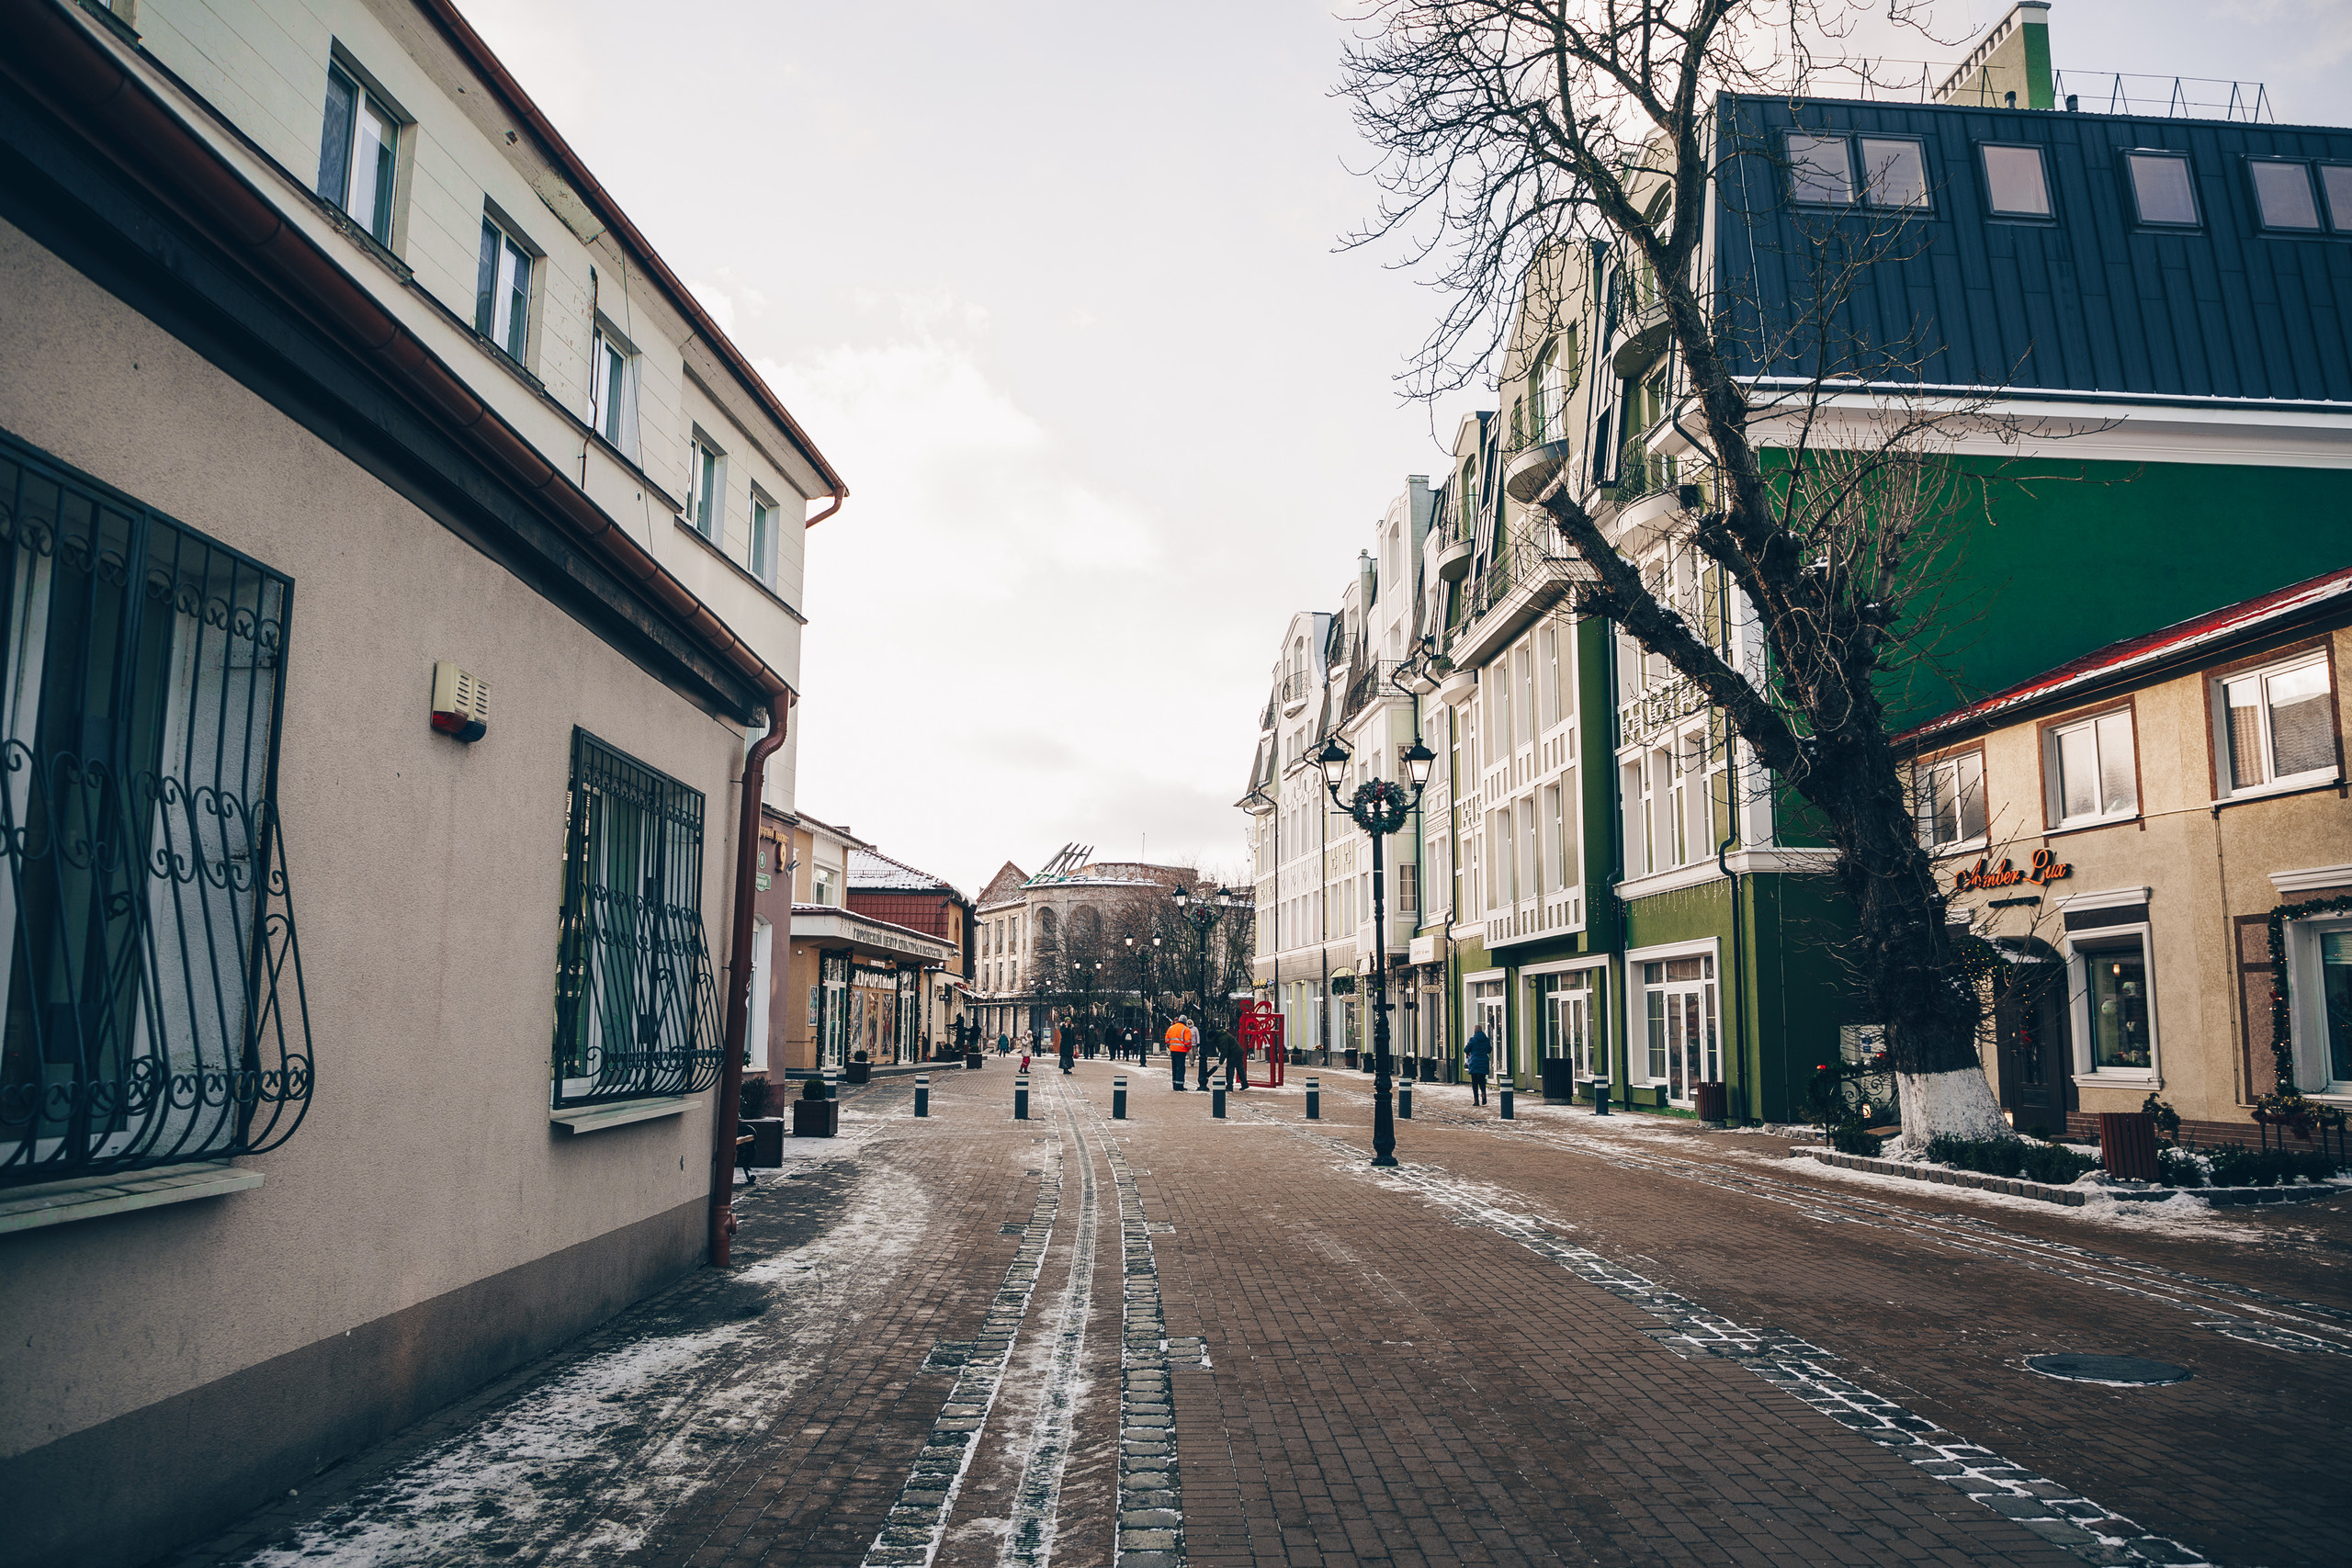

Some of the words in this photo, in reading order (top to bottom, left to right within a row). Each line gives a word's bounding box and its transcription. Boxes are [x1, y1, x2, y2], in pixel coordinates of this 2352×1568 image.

[1955, 859, 2020, 891] Amber
[2022, 849, 2067, 886] Lux
[854, 927, 882, 945] ГОРОДСКОЙ
[883, 935, 898, 948] ЦЕНТР
[899, 939, 919, 953] КУЛЬТУРЫ
[919, 943, 922, 954] И
[922, 945, 944, 959] ИСКУССТВА
[855, 969, 897, 990] КУРОРТНЫЙ
